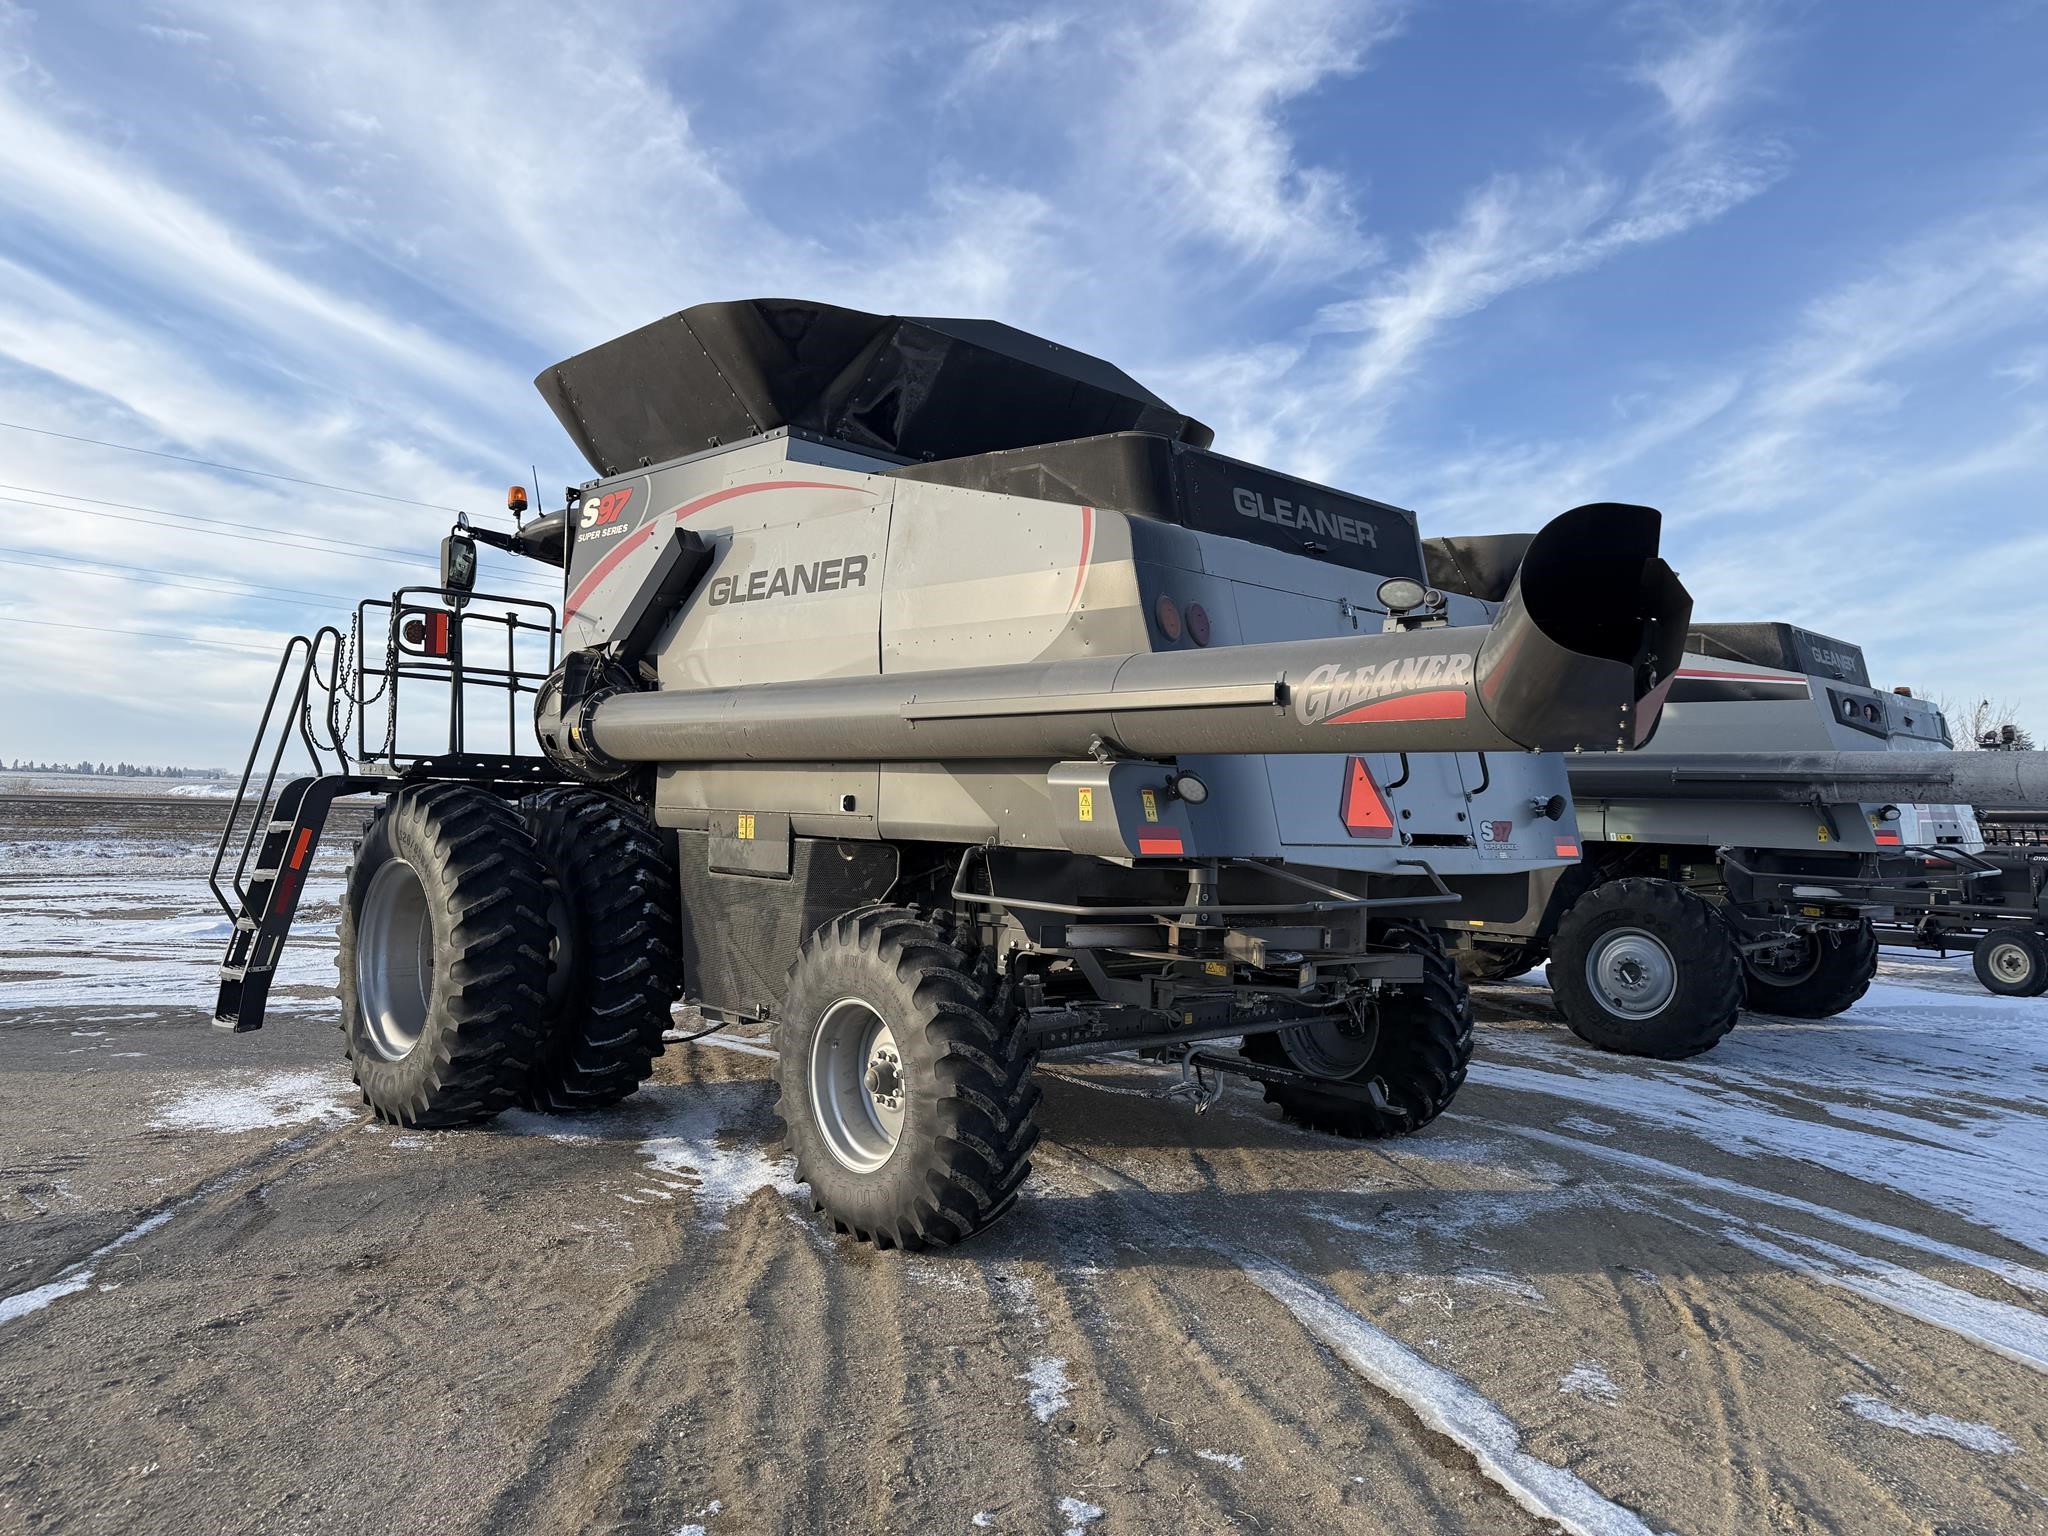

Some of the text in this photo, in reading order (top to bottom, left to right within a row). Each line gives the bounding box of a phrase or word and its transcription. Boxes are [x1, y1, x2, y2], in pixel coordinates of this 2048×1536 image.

[580, 487, 633, 529] S97
[1232, 487, 1377, 549] GLEANER
[578, 523, 629, 543] SUPER SERIES
[708, 554, 869, 607] GLEANER
[1811, 646, 1857, 672] GLEANER
[1295, 653, 1472, 726] GLEANER
[1480, 820, 1513, 843] S97
